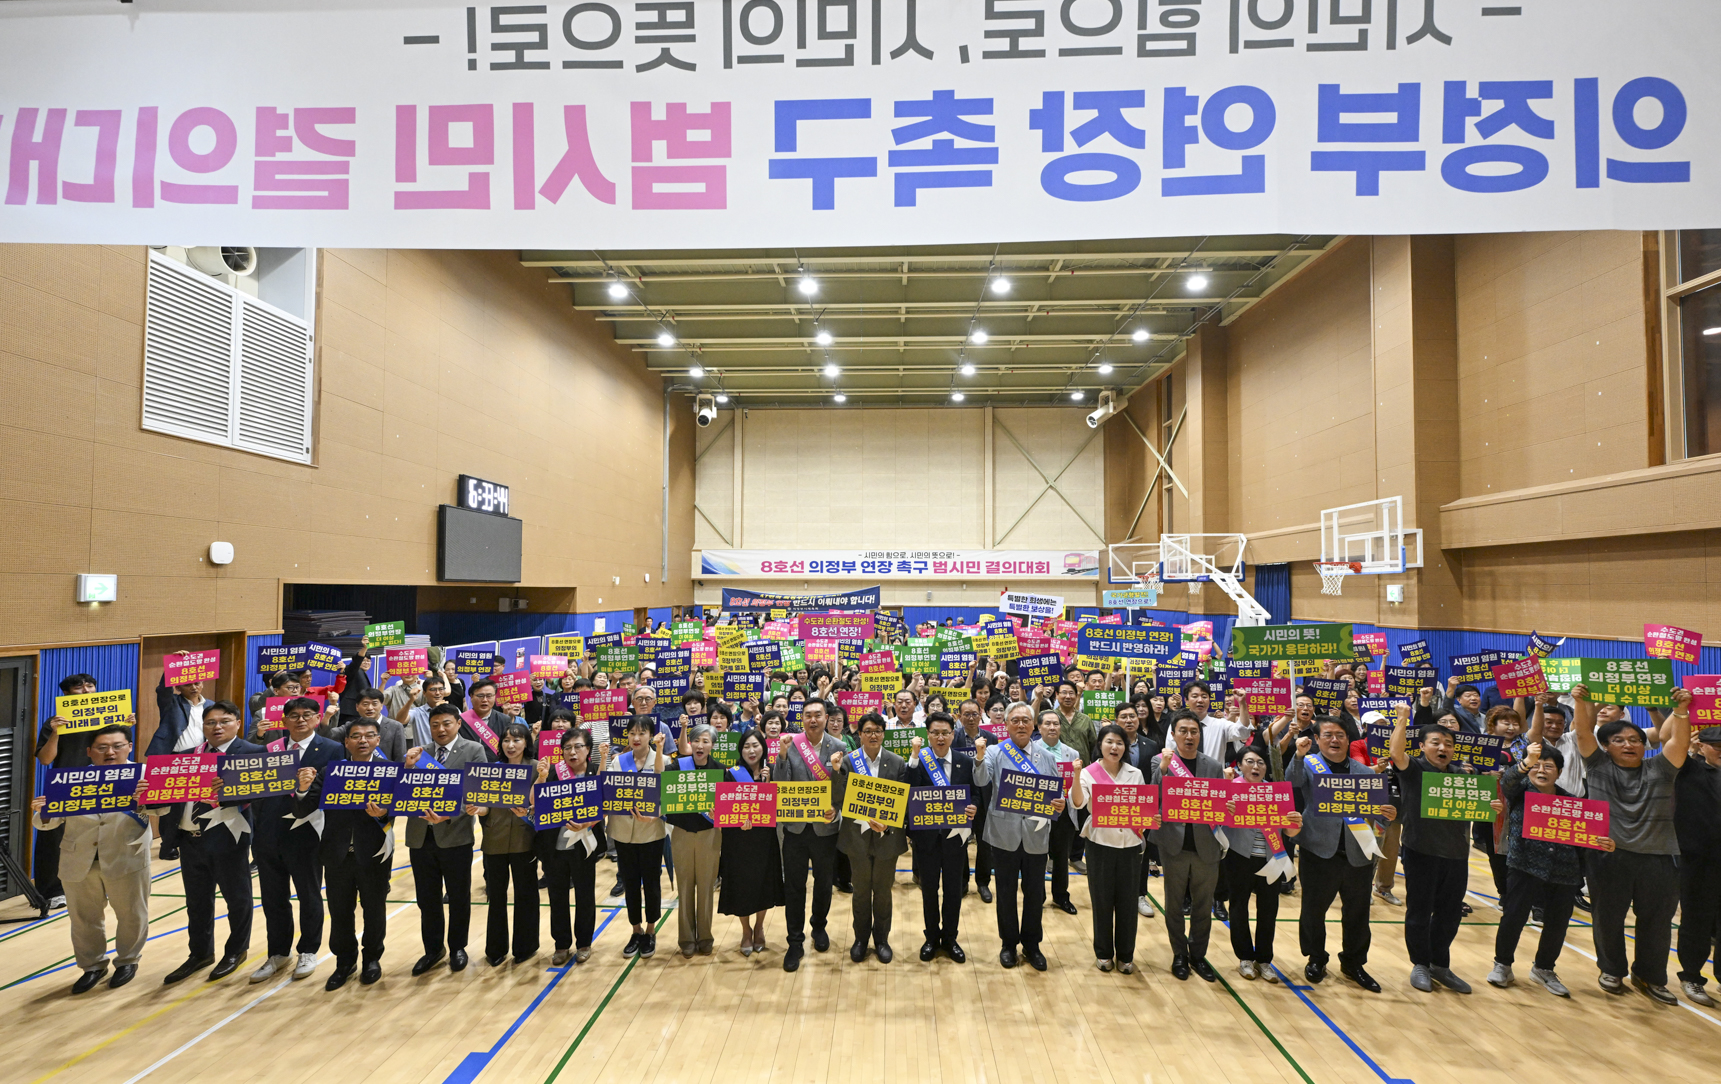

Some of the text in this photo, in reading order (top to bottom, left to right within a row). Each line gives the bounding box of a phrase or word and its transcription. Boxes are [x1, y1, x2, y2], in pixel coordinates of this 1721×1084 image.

[760, 560, 1050, 574] 8호선 의정부 연장 촉구 범시민 결의대회
[818, 597, 848, 606] 이뤄내야
[850, 595, 875, 605] 합니다!
[1009, 603, 1054, 614] 특별한 보상을!
[804, 617, 824, 625] 수도권
[811, 627, 861, 637] 8호선 연장!
[1085, 628, 1174, 642] 8호선 의정부 연장!
[1264, 629, 1320, 641] 시민의 뜻!
[1661, 627, 1684, 636] 수도권
[1090, 641, 1168, 655] 반드시 반영하라!
[1249, 643, 1337, 656] 국가가 응답하라!
[1655, 640, 1685, 651] 8호선
[1648, 647, 1694, 661] 의정부 연장
[260, 661, 305, 672] 의정부 연장
[1020, 656, 1057, 668] 시민의 염원
[1607, 661, 1649, 672] 8호선
[181, 665, 205, 675] 8호선
[1028, 667, 1048, 676] 8호선
[170, 671, 215, 684] 의정부 연장
[1022, 674, 1060, 686] 의정부 연장
[1589, 672, 1666, 684] 의정부연장
[1608, 685, 1651, 694] 더 이상
[62, 694, 126, 707] 8호선 연장으로
[1591, 693, 1669, 705] 미룰 수 없다!
[72, 705, 118, 717] 의정부의
[66, 715, 125, 729] 미래를 열자
[222, 754, 294, 770] 시민의 염원
[51, 768, 135, 784] 시민의 염원
[240, 769, 277, 782] 8호선
[330, 766, 398, 777] 시민의 염원
[678, 772, 707, 782] 8호선
[223, 779, 296, 796] 의정부 연장
[344, 780, 380, 791] 8호선
[852, 779, 905, 796] 8호선 연장으로
[1318, 778, 1383, 789] 시민의 염원
[1443, 777, 1478, 788] 8호선
[70, 783, 113, 797] 8호선
[539, 780, 597, 798] 시민의 염원
[1428, 787, 1491, 801] 의정부연장
[325, 793, 365, 804] 의정부
[679, 793, 707, 802] 더 이상
[720, 793, 772, 801] 순환철도망 완성
[856, 792, 895, 808] 의정부의
[912, 789, 966, 801] 시민의 염원
[1334, 791, 1368, 802] 8호선
[48, 795, 131, 813] 의정부 연장
[553, 795, 584, 809] 8호선
[667, 803, 684, 812] 미룰
[687, 803, 695, 811] 수
[732, 803, 760, 812] 8호선
[926, 803, 954, 812] 8호선
[1443, 800, 1477, 810] 더 이상
[849, 803, 898, 822] 미래를 열자
[1111, 806, 1140, 815] 8호선
[1318, 804, 1356, 814] 의정부
[1428, 808, 1489, 820] 미룰 수 없다!
[540, 806, 598, 825] 의정부 연장
[719, 814, 771, 824] 의정부 연장
[914, 814, 967, 825] 의정부 연장
[1098, 816, 1152, 826] 의정부 연장
